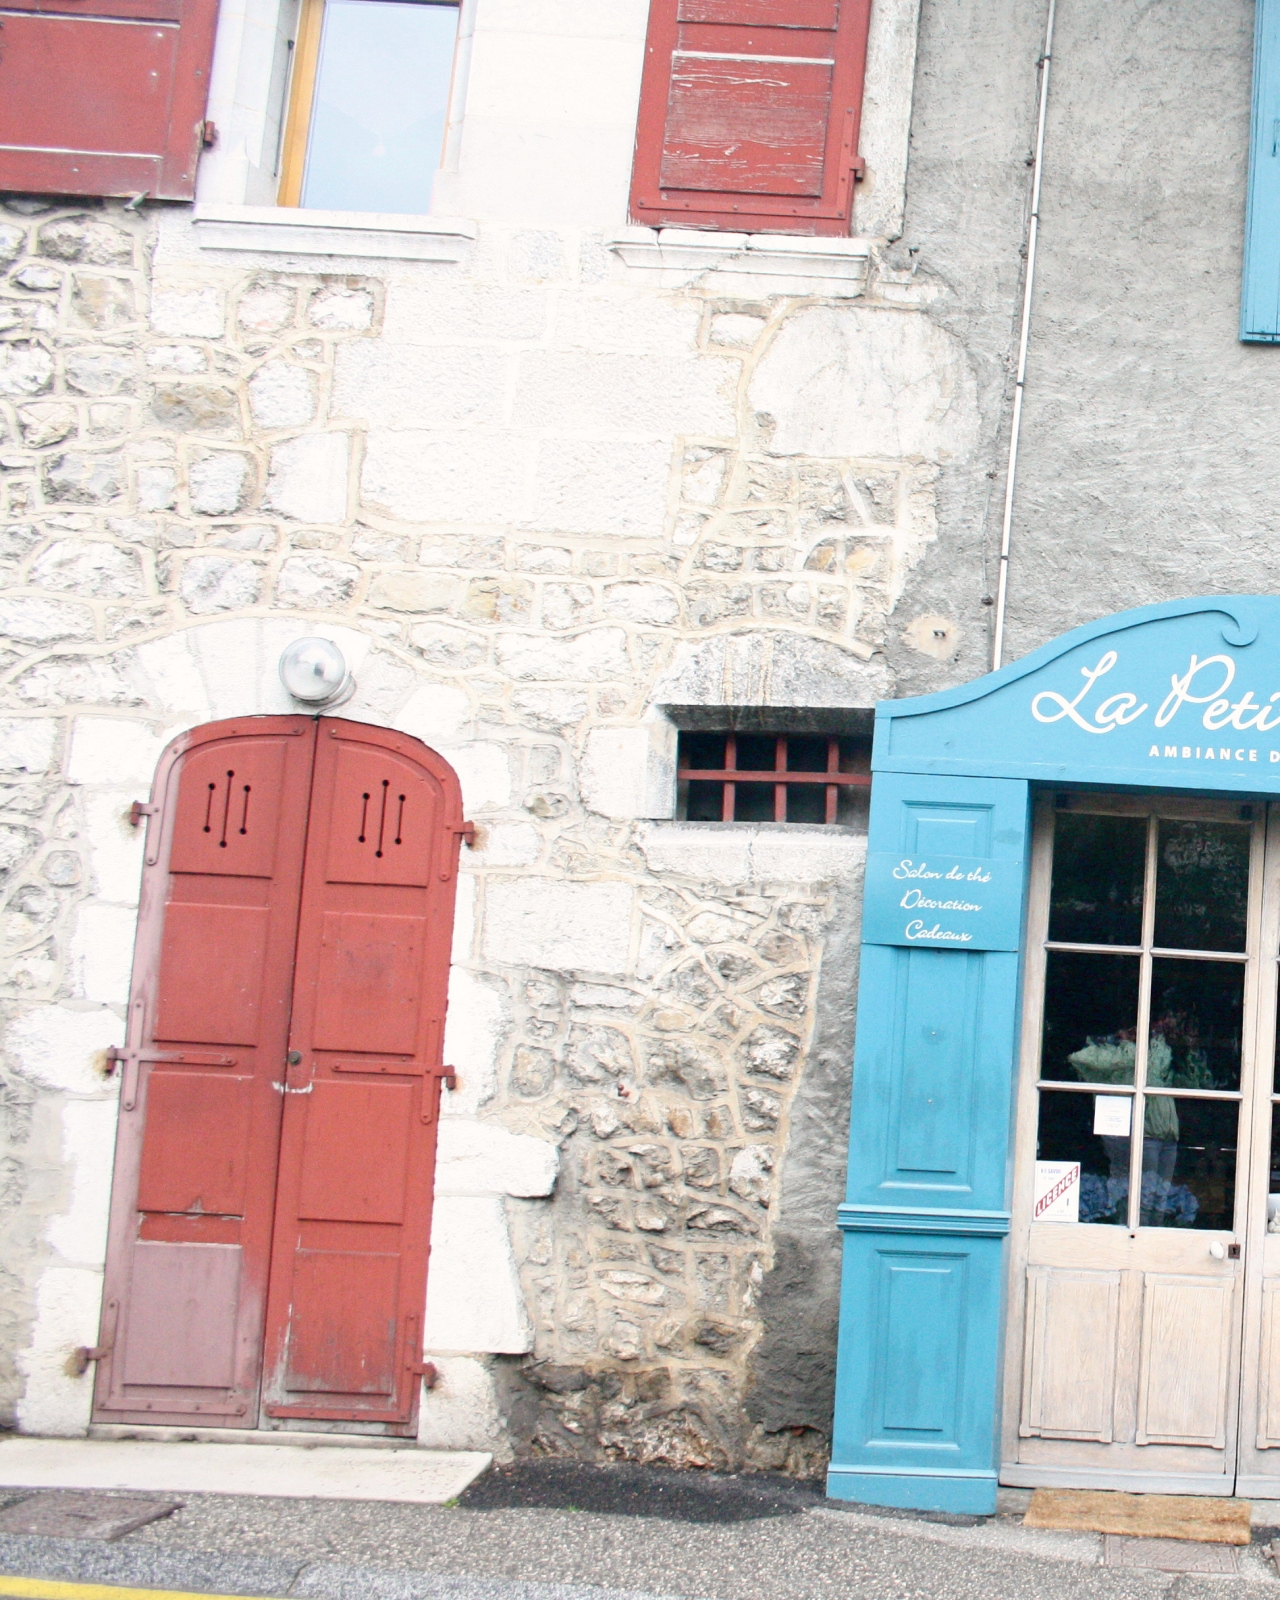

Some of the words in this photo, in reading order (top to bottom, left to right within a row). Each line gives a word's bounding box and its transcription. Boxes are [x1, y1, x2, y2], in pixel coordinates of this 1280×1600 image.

[1031, 651, 1148, 733] La
[1148, 745, 1258, 762] AMBIANCE
[892, 859, 943, 880] Salon
[945, 865, 965, 880] de
[966, 866, 992, 883] thé
[899, 889, 983, 912] Décoration
[905, 919, 973, 941] Cadeaux
[1036, 1167, 1078, 1215] LICENCE
